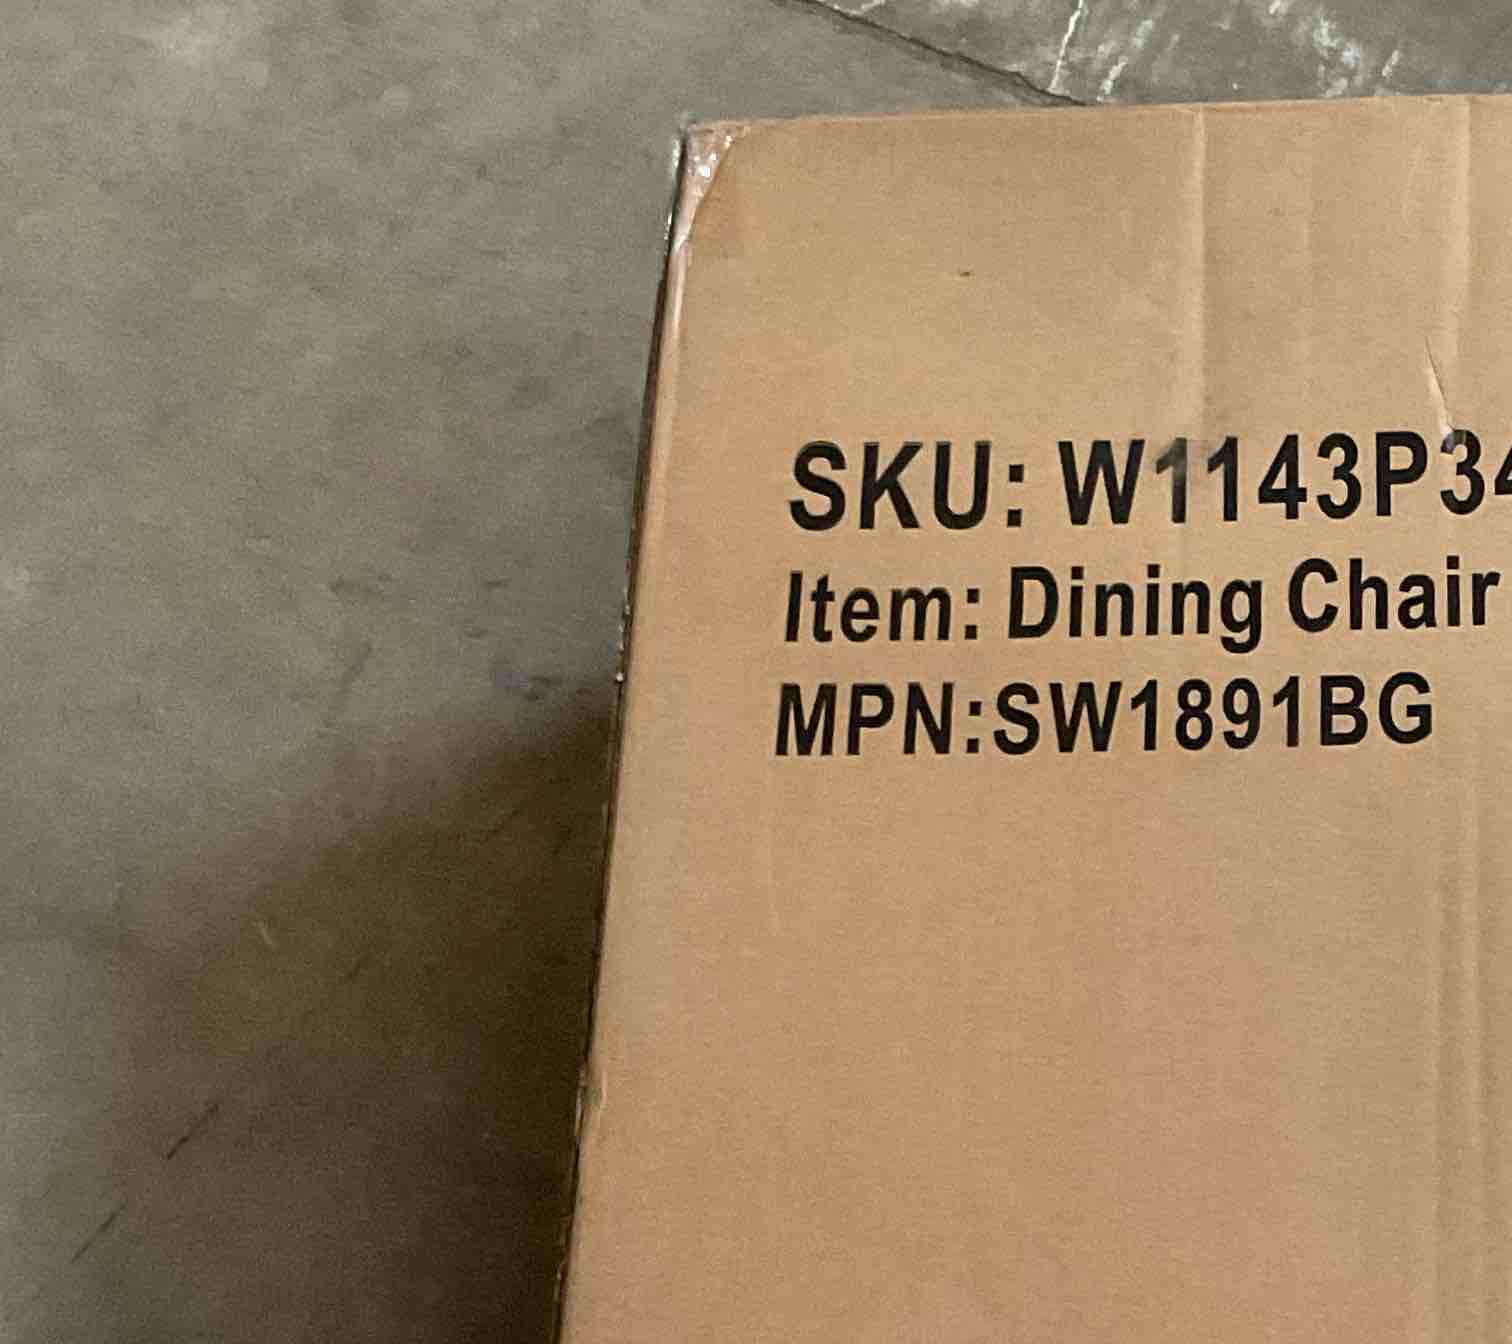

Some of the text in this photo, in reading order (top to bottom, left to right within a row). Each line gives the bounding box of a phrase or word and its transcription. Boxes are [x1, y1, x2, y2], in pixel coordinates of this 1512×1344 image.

[789, 441, 1024, 531] SKU:
[785, 556, 1500, 653] Item: Dining Chair
[776, 672, 1432, 756] MPN:SW1891BG
